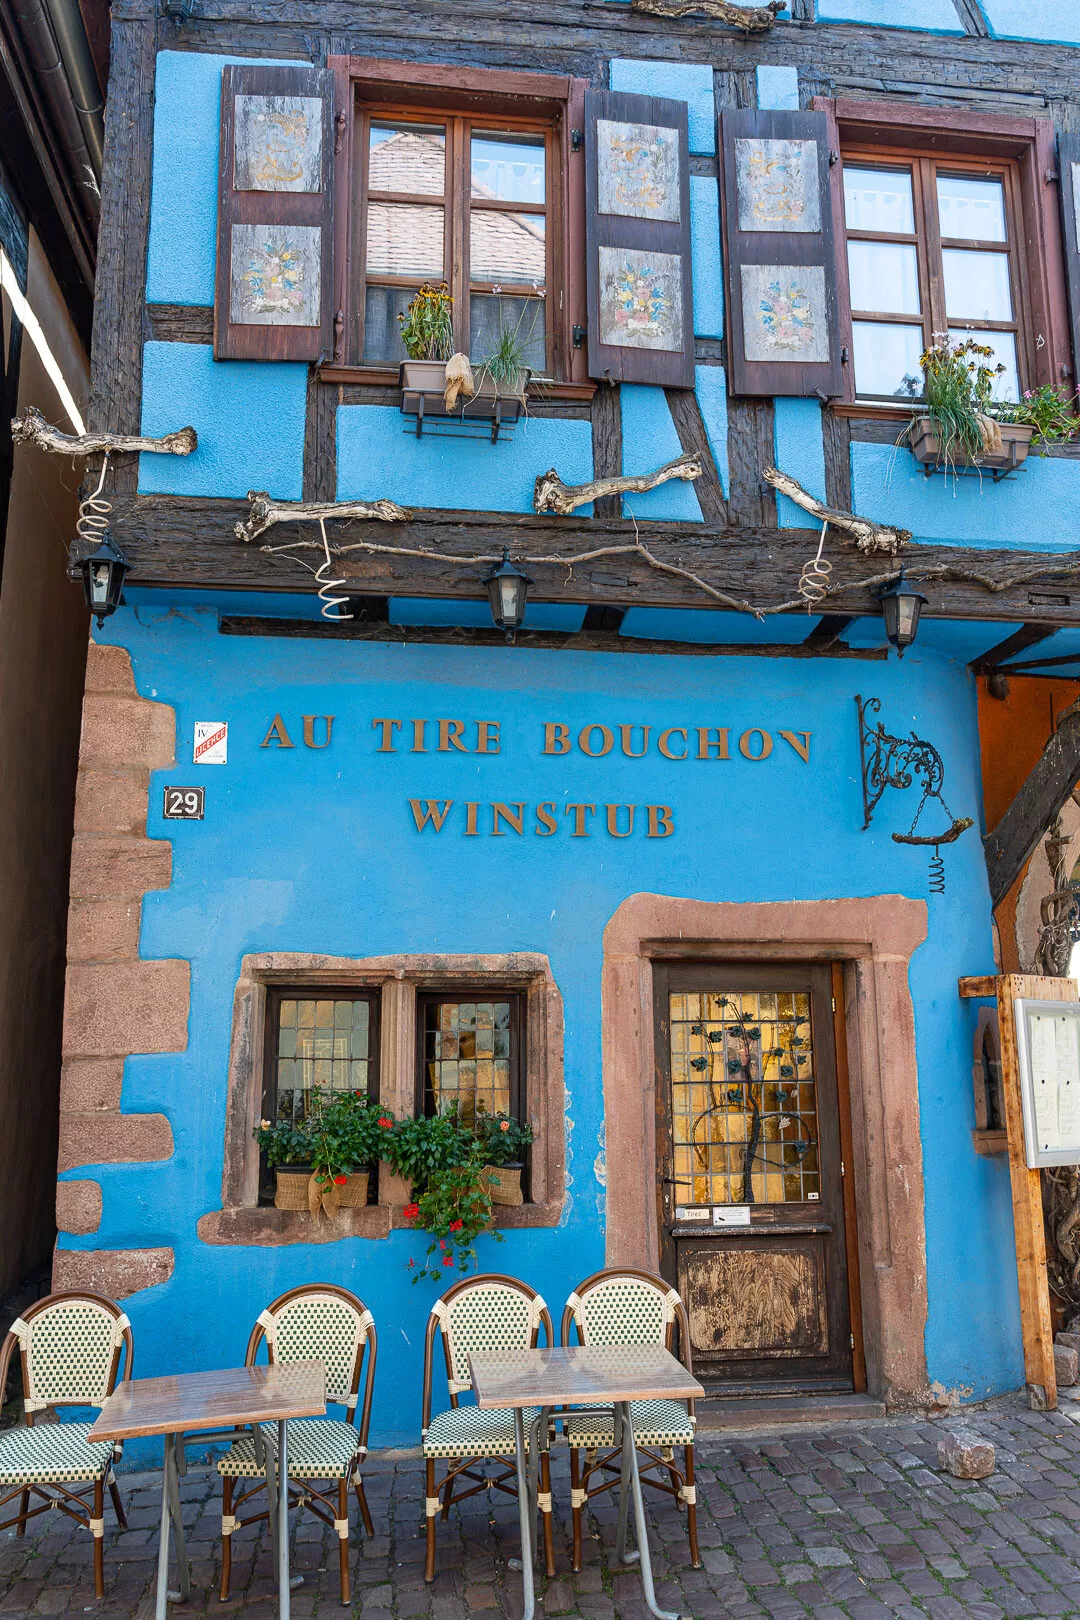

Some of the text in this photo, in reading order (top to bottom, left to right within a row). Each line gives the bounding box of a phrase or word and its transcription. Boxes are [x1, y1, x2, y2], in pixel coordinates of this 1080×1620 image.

[196, 728, 225, 757] LICENCE
[259, 712, 813, 764] AU TIRE BOUCHON
[170, 791, 199, 814] 29
[407, 798, 675, 838] WINSTUB
